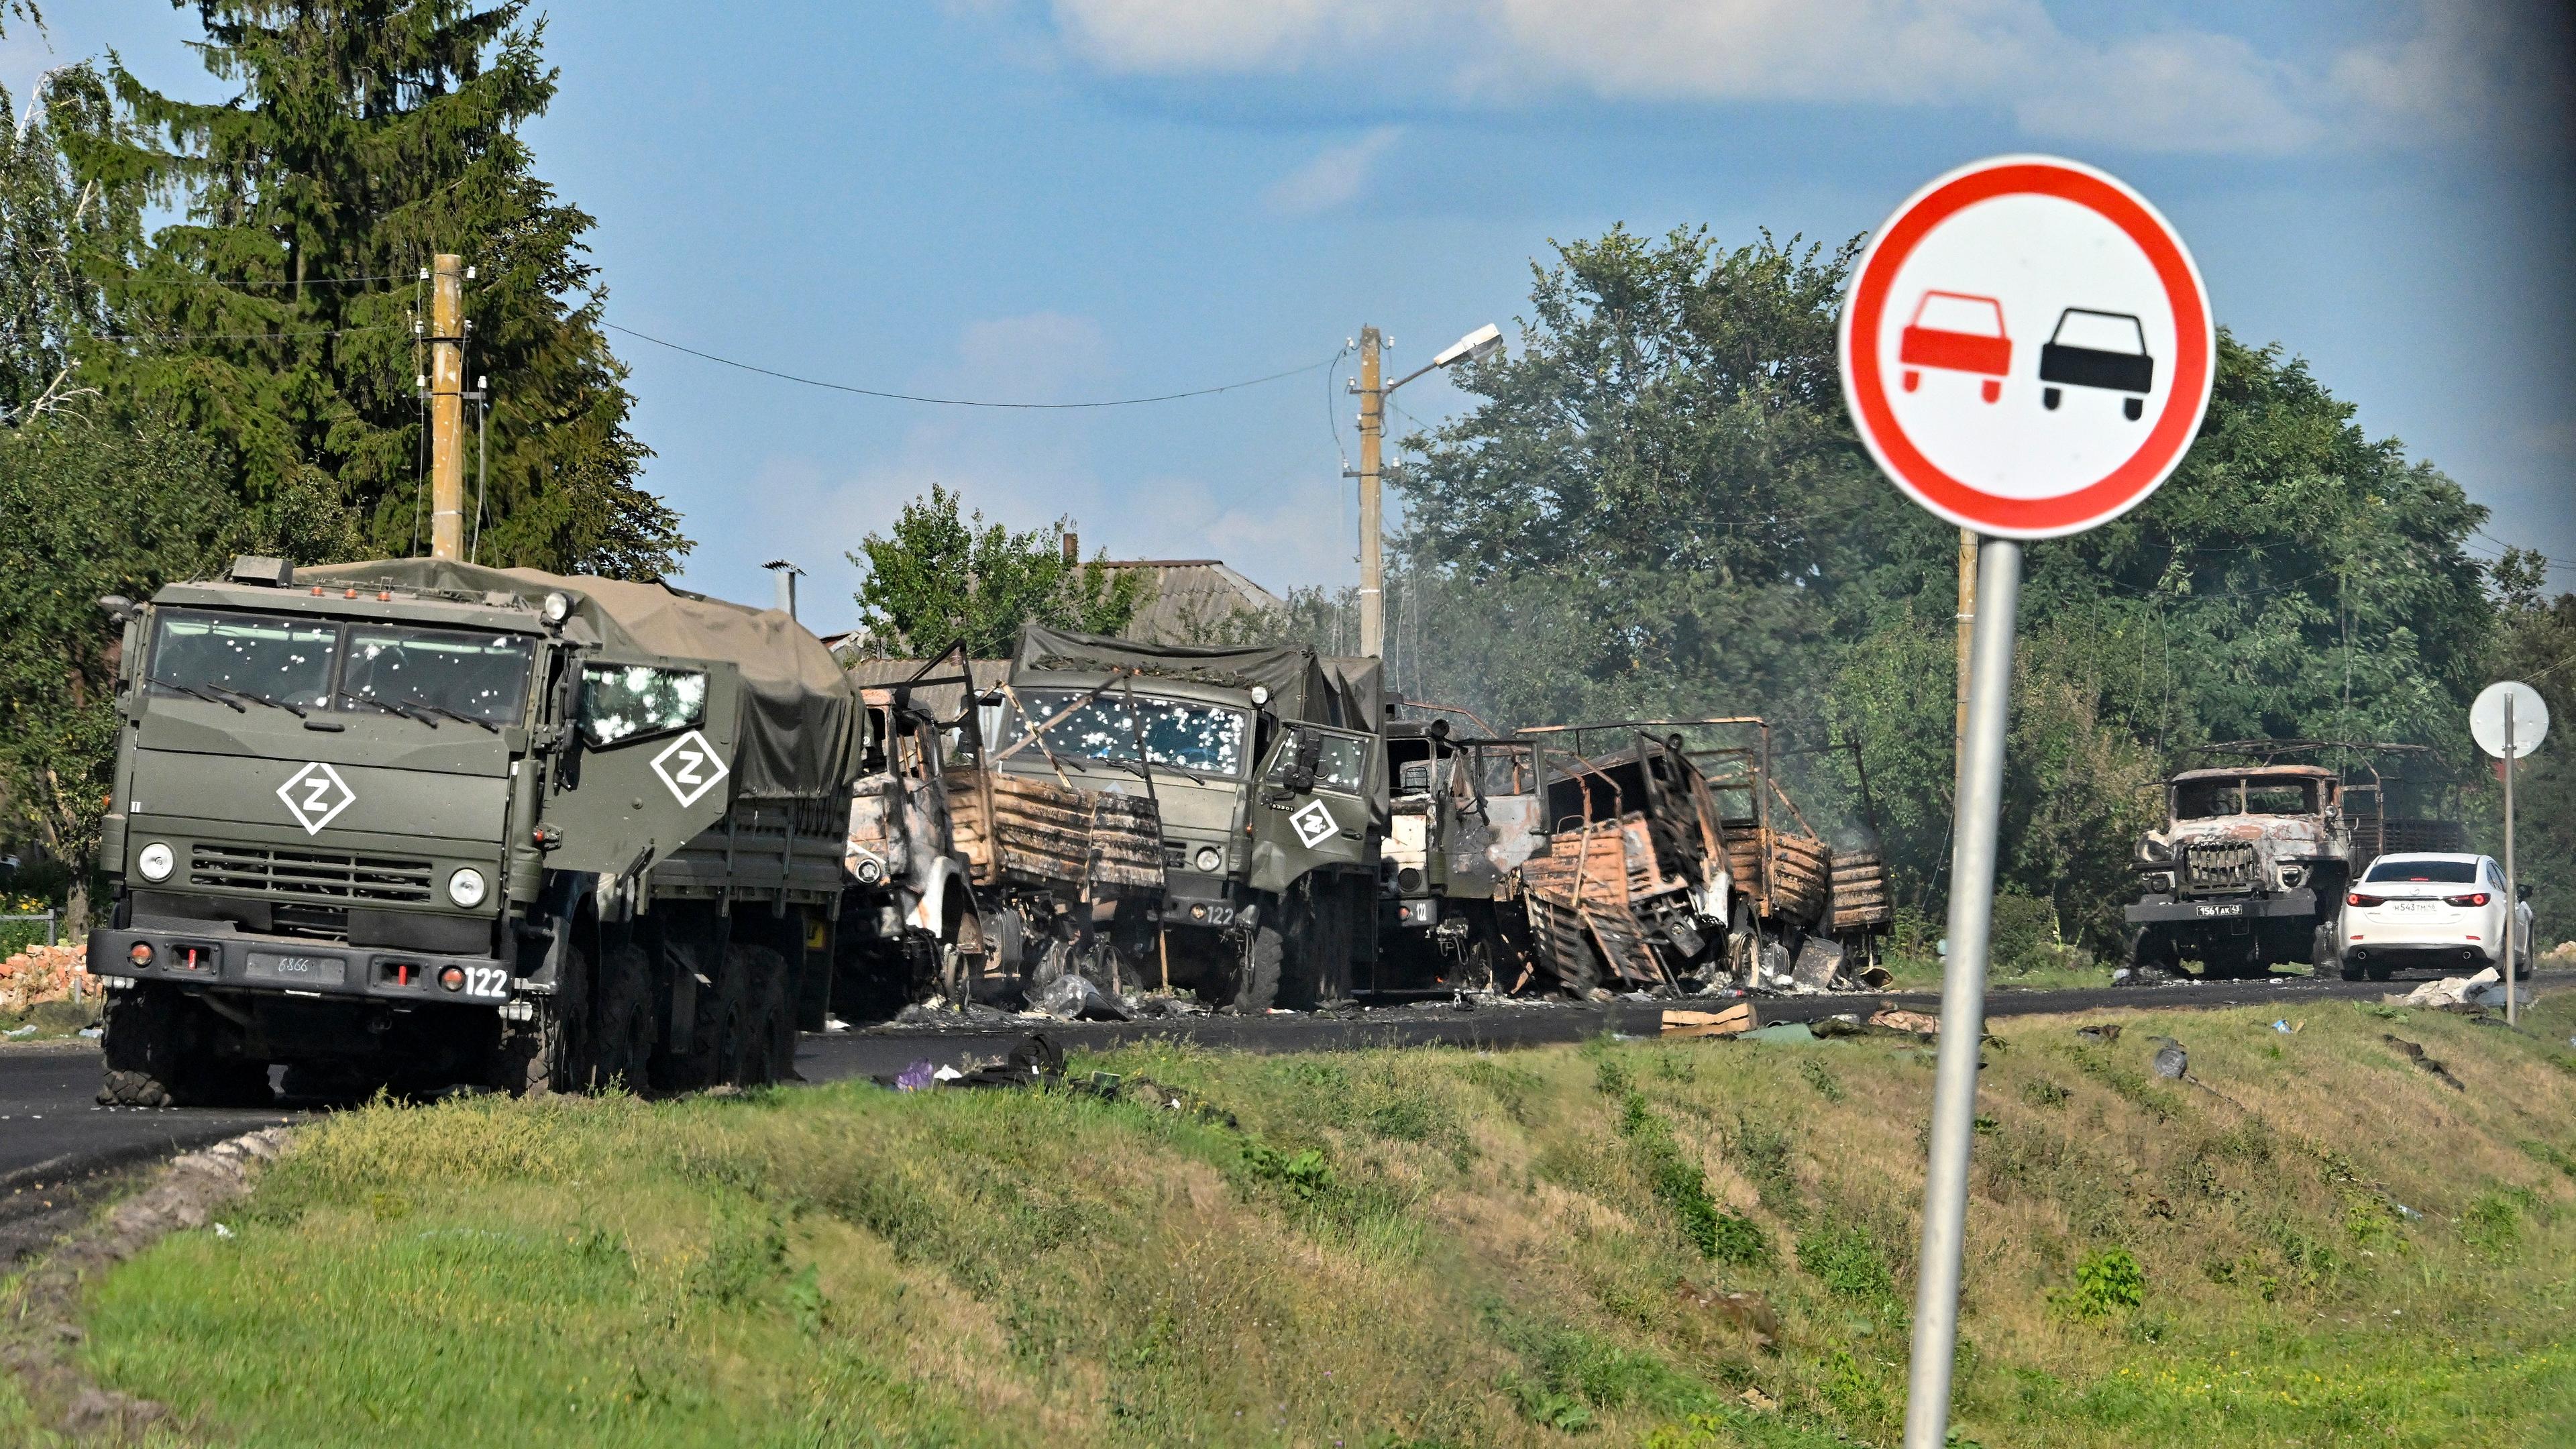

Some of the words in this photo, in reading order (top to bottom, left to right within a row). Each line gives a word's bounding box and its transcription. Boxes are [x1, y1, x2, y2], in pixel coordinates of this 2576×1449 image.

[676, 751, 704, 784] Z
[303, 778, 330, 812] Z
[1272, 804, 1293, 812] 53501
[1208, 906, 1234, 925] 122
[1416, 903, 1427, 921] 122
[278, 958, 309, 972] 6866
[465, 967, 508, 998] 122
